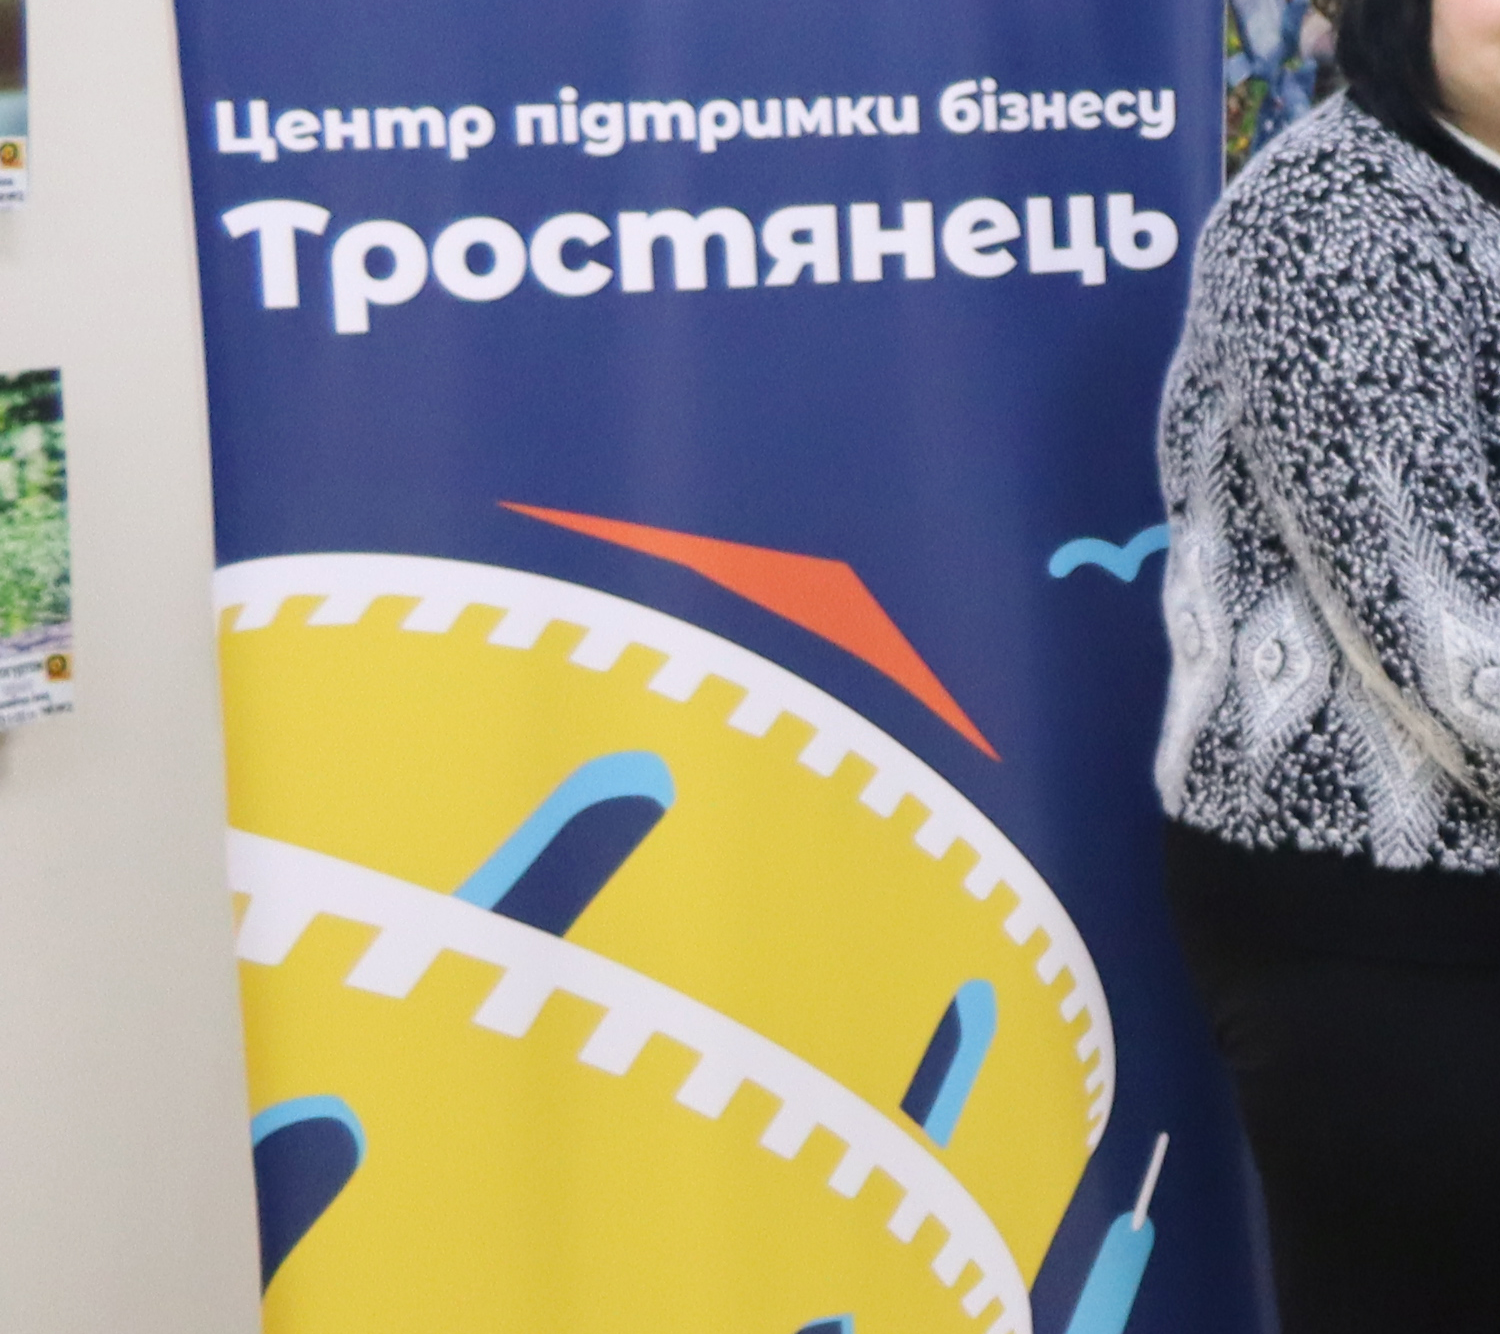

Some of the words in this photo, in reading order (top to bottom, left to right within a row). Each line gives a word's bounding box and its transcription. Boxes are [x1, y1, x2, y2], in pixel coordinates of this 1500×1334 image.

[214, 98, 496, 163] Центр
[514, 84, 920, 157] підтримки
[938, 76, 1177, 141] бізнесу
[220, 191, 1180, 336] Тростянець
